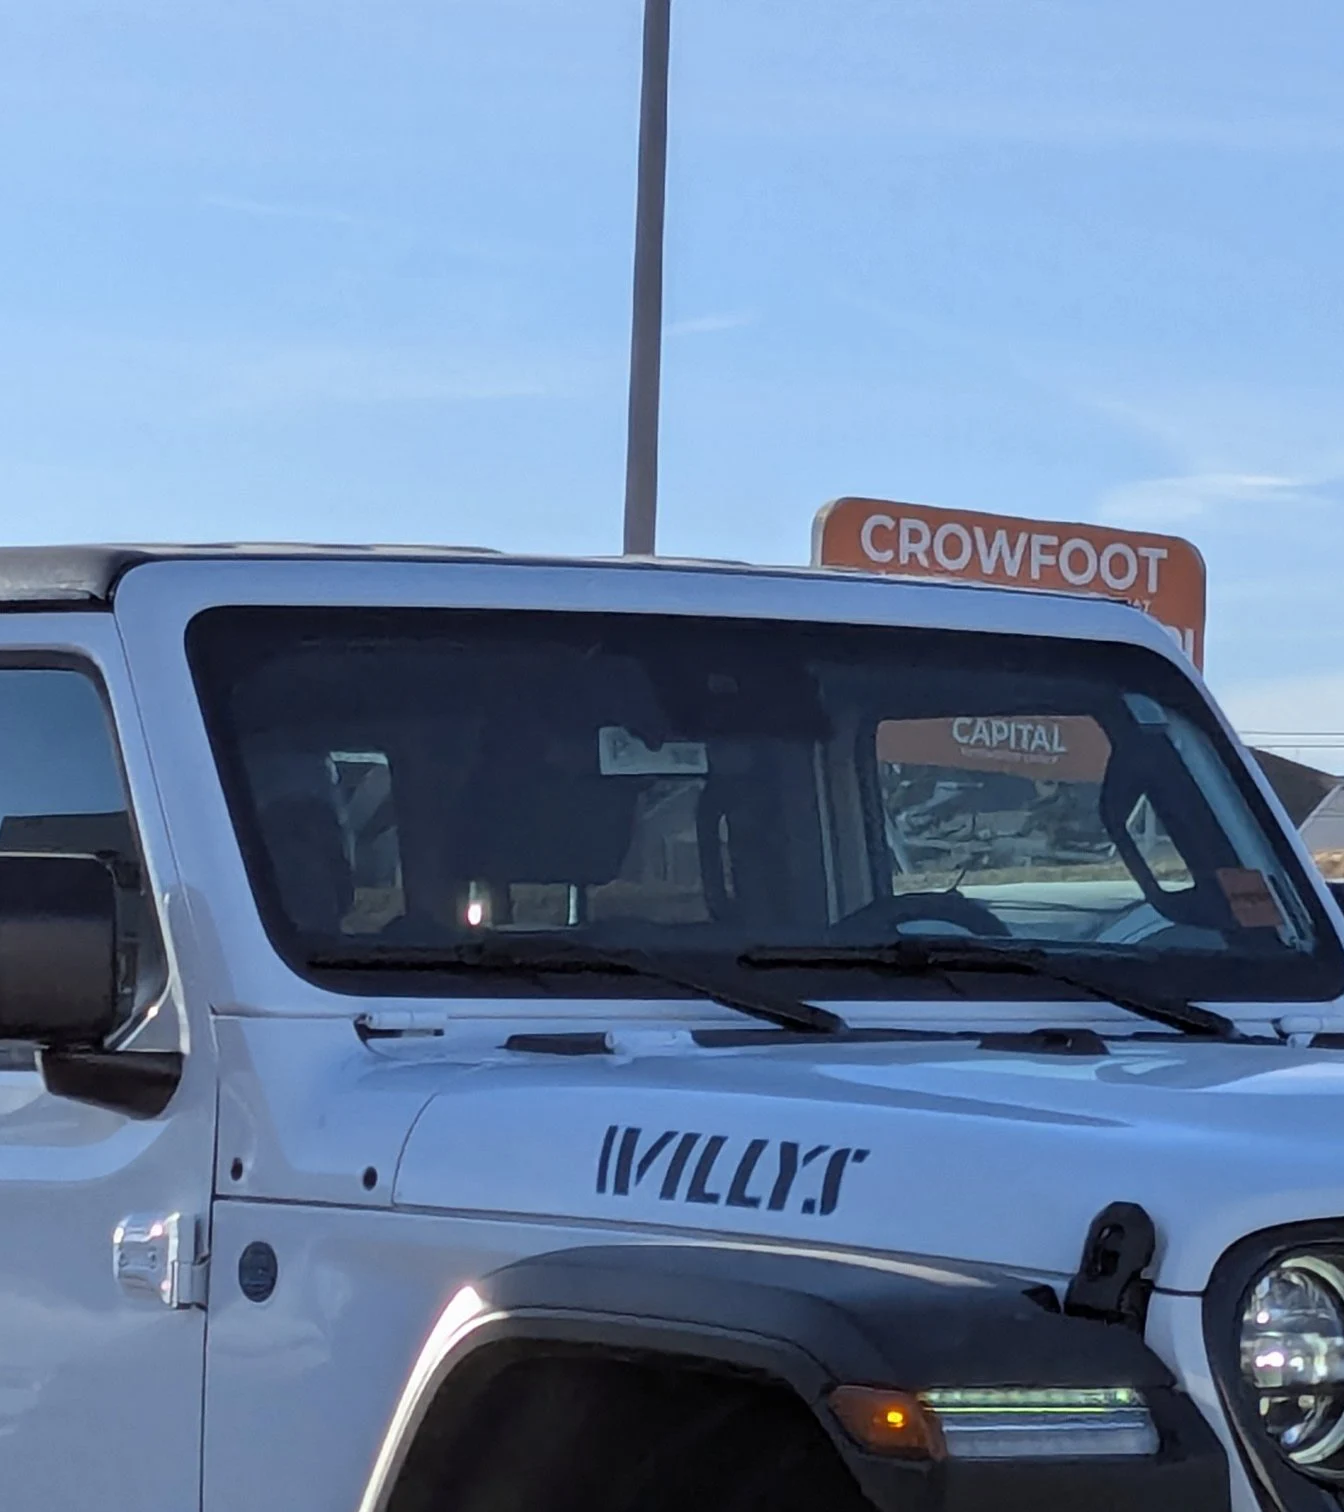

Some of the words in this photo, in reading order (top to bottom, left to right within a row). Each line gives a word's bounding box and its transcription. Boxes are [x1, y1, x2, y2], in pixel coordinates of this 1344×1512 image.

[860, 513, 1169, 594] CROWFOOT
[951, 716, 1068, 753] CAPITAL
[595, 1124, 871, 1217] WILLYS
